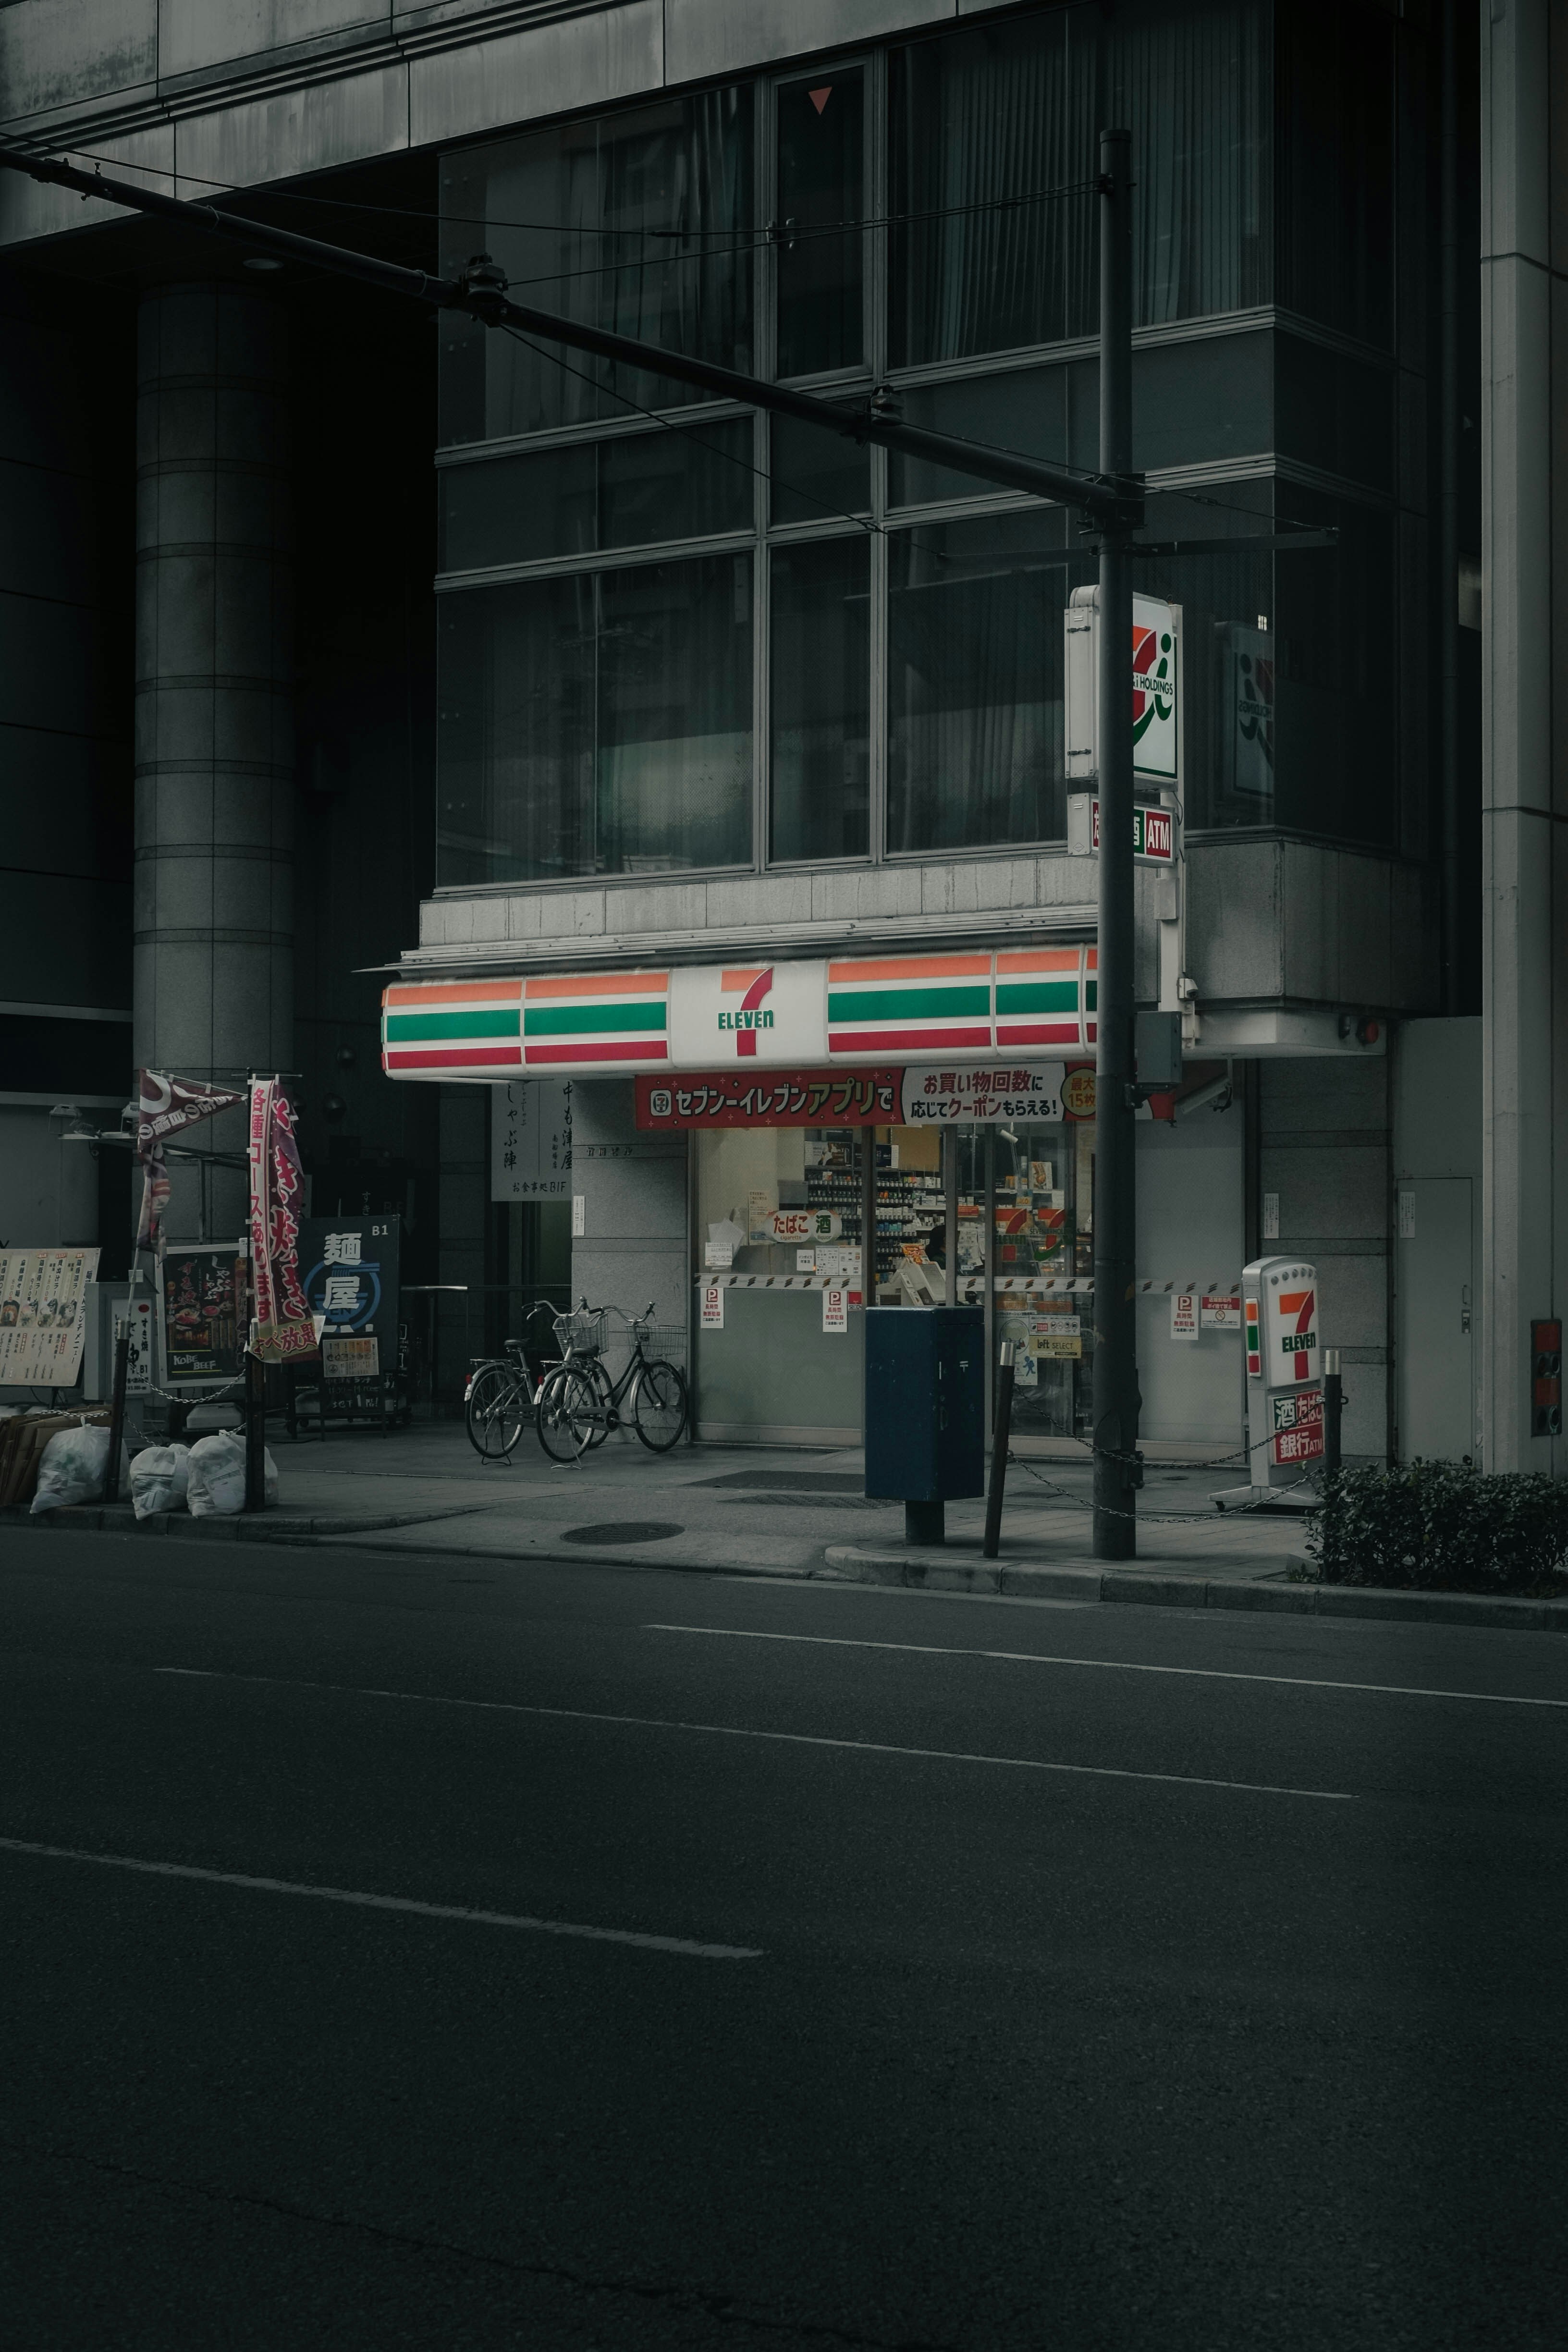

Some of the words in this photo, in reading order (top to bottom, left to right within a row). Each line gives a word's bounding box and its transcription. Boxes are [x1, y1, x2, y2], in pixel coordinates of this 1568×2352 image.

[1140, 676, 1173, 695] HOLDINGS
[1148, 819, 1170, 851] ATM
[721, 967, 773, 1056] 7
[924, 1070, 1043, 1094] お買い物回数に
[1071, 1078, 1094, 1091] 最大
[1068, 1093, 1096, 1107] 15枚
[504, 1084, 517, 1171] しゃぶ陣
[561, 1081, 572, 1169] 中も津屋
[250, 1088, 271, 1323] 各種コースあります
[372, 1225, 389, 1236] B1
[774, 1215, 809, 1233] たばこ
[816, 1215, 831, 1234] 酒
[323, 1233, 362, 1310] 麺屋
[708, 1289, 717, 1301] P
[830, 1292, 840, 1305] P
[1180, 1297, 1190, 1310] P
[1037, 1339, 1050, 1349] Loft
[1279, 1290, 1314, 1381] 7
[140, 1365, 147, 1373] B1
[173, 1354, 199, 1366] KOBE
[193, 1360, 217, 1370] BEEF
[1276, 1398, 1296, 1429] 酒
[1279, 1432, 1310, 1459] 銀行
[1310, 1438, 1323, 1454] ATM
